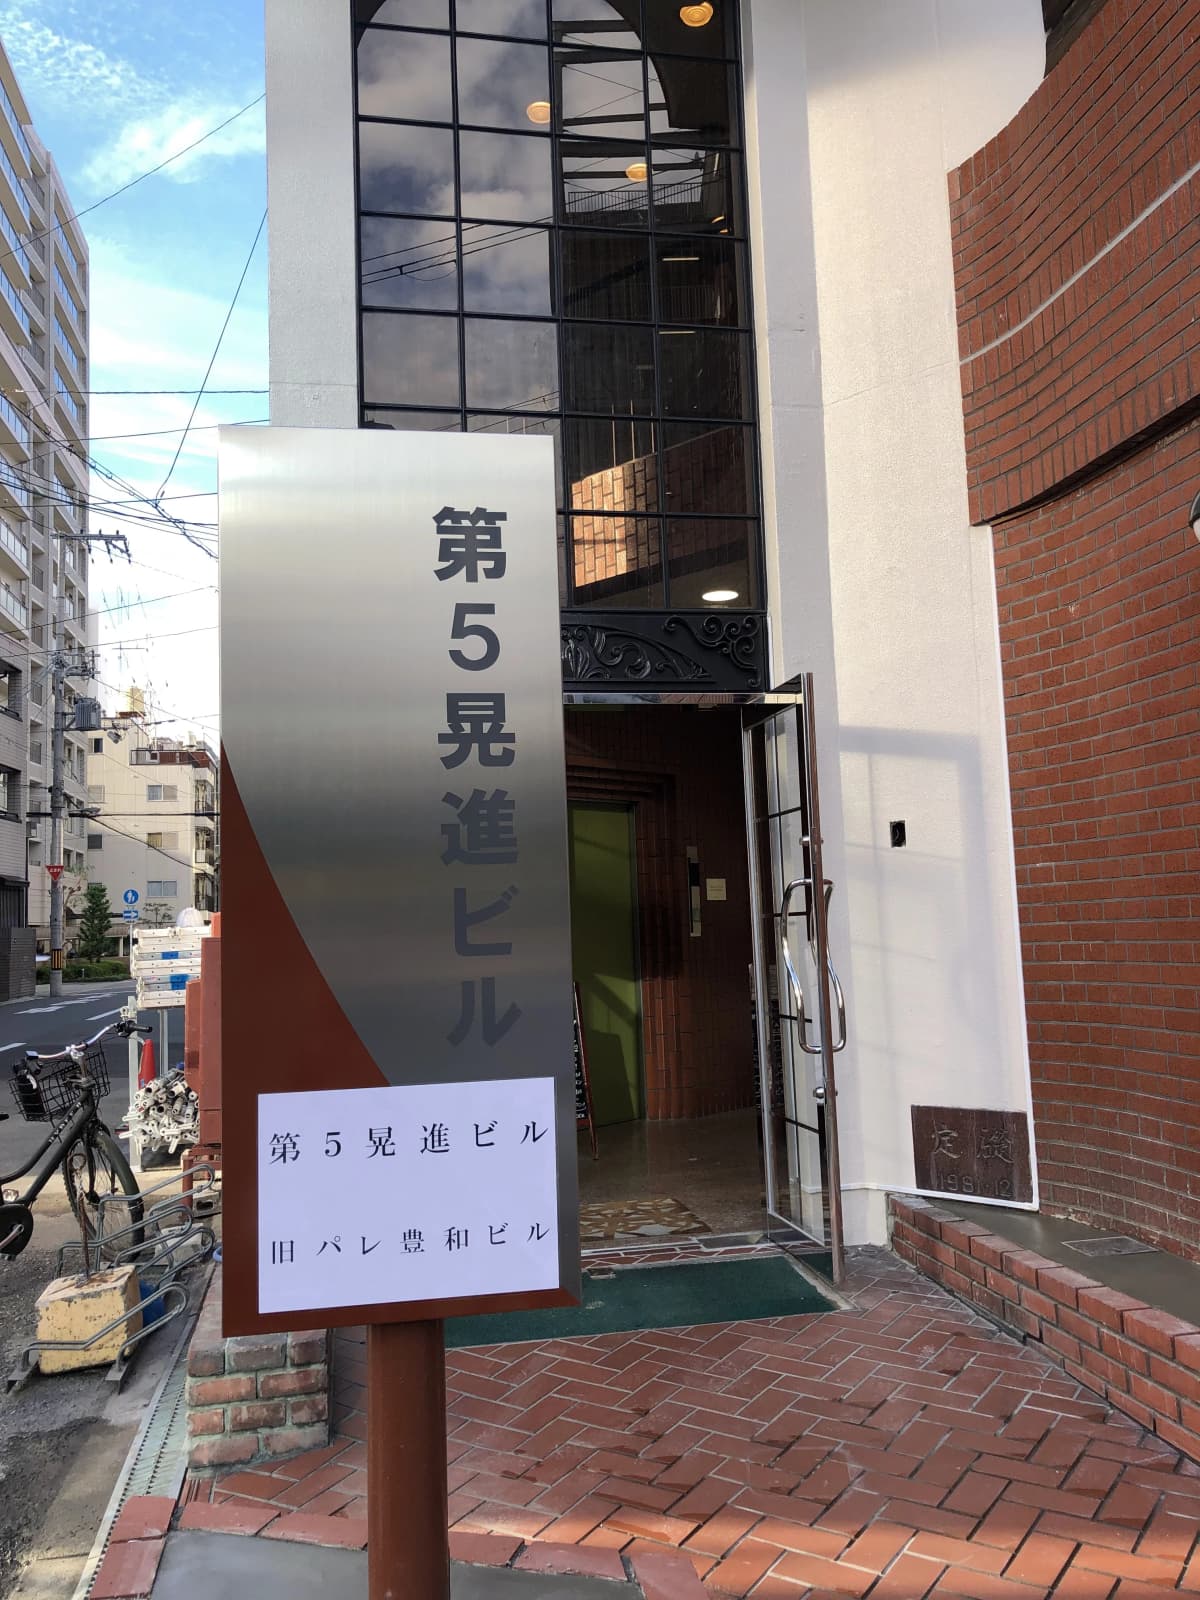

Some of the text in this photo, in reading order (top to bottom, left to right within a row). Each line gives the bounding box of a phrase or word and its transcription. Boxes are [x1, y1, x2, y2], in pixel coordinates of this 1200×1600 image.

[432, 506, 522, 1047] 第5晃進ビル
[268, 1120, 549, 1165] 第5晃進ビル
[271, 1222, 550, 1264] 旧パレ豊和ビル
